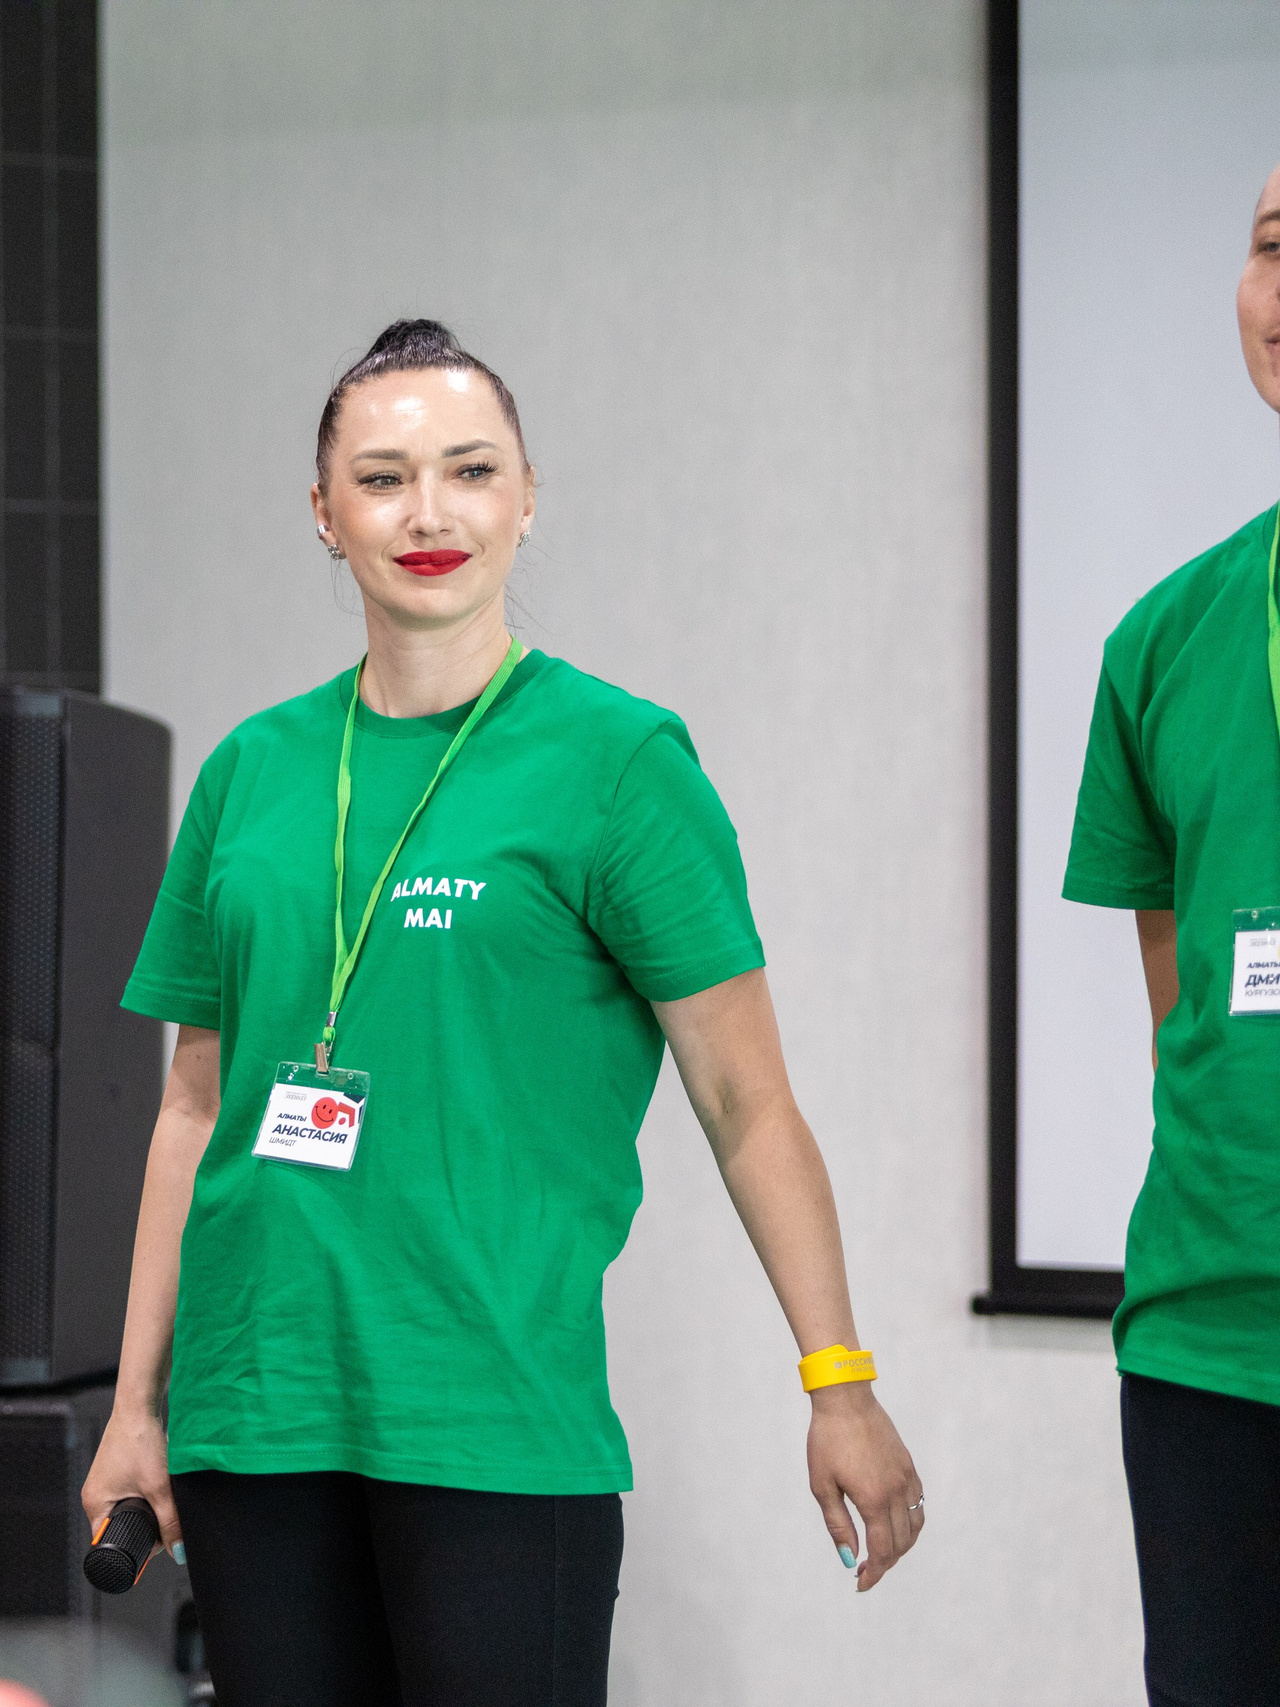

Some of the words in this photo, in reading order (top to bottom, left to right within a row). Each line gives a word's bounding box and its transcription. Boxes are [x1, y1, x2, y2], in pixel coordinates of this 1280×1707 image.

[390, 877, 487, 901] ALMATY
[404, 908, 453, 929] MAI
[277, 1112, 307, 1122] АЛМАТЫ
[269, 1136, 297, 1147] ШМИДТ
[272, 1124, 348, 1144] АНАСТАСИЯ
